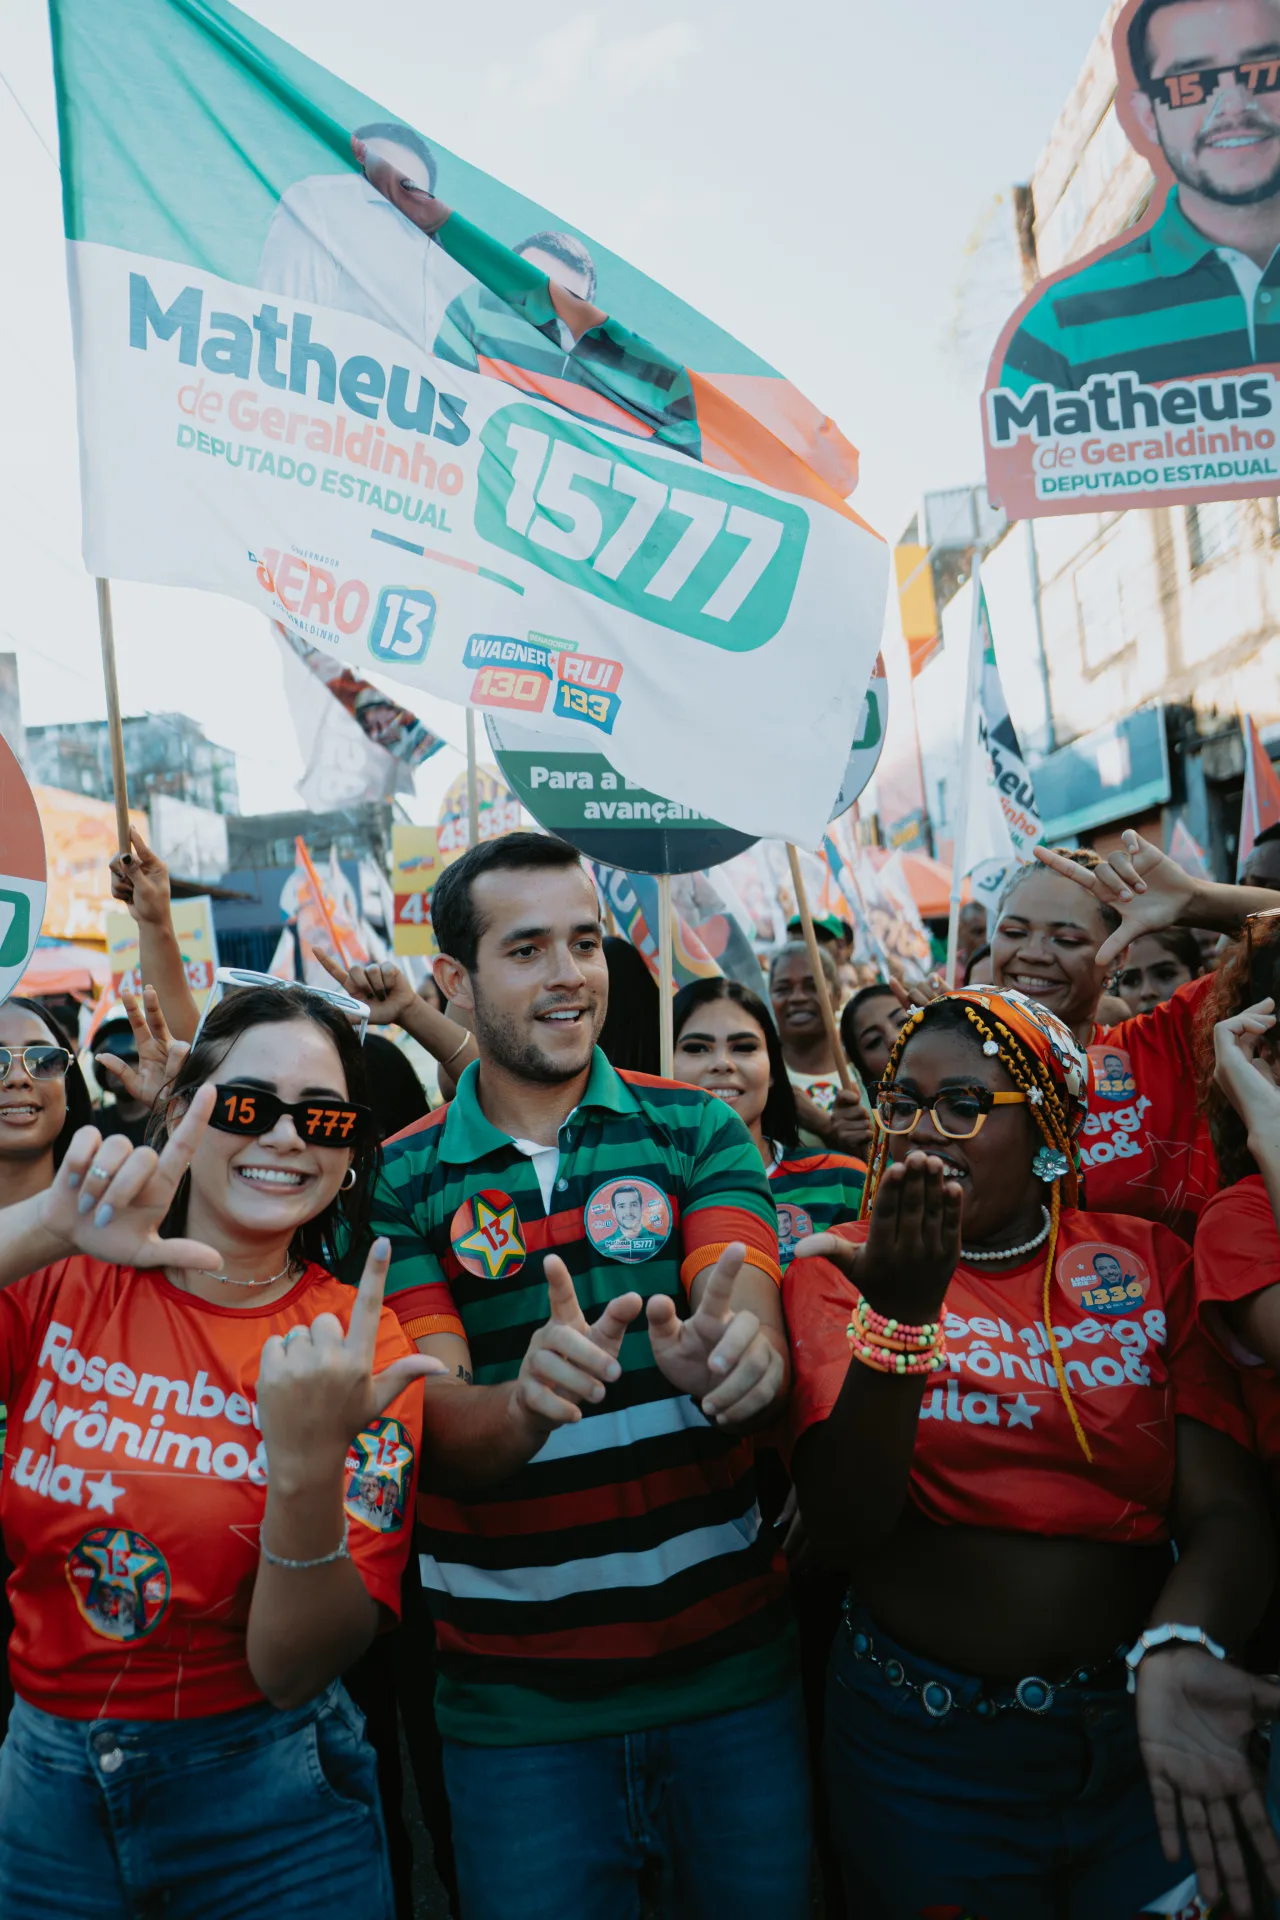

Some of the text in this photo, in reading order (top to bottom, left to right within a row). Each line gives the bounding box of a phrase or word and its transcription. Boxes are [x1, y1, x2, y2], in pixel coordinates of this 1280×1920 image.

[1165, 73, 1204, 107] 15
[128, 271, 471, 447] Matheus
[993, 376, 1273, 442] Matheus
[178, 378, 464, 497] de Geraldinho
[1039, 425, 1276, 470] de Geraldinho
[177, 424, 452, 534] DEPUTADO ESTADUAL
[1041, 457, 1278, 493] DEPUTADO ESTADUAL
[505, 422, 785, 622] 15777
[380, 593, 431, 656] 13
[470, 638, 547, 668] WAGNER
[479, 669, 541, 701] 130
[563, 657, 614, 688] RUI
[561, 684, 611, 722] 133
[530, 766, 594, 790] Para
[600, 771, 617, 790] a
[583, 801, 714, 824] avançan
[224, 1095, 357, 1138] 15 777
[480, 1217, 510, 1252] 13
[632, 1240, 653, 1249] 15777
[1081, 1282, 1143, 1307] 1330
[376, 1437, 400, 1468] 13
[105, 1547, 132, 1578] 13
